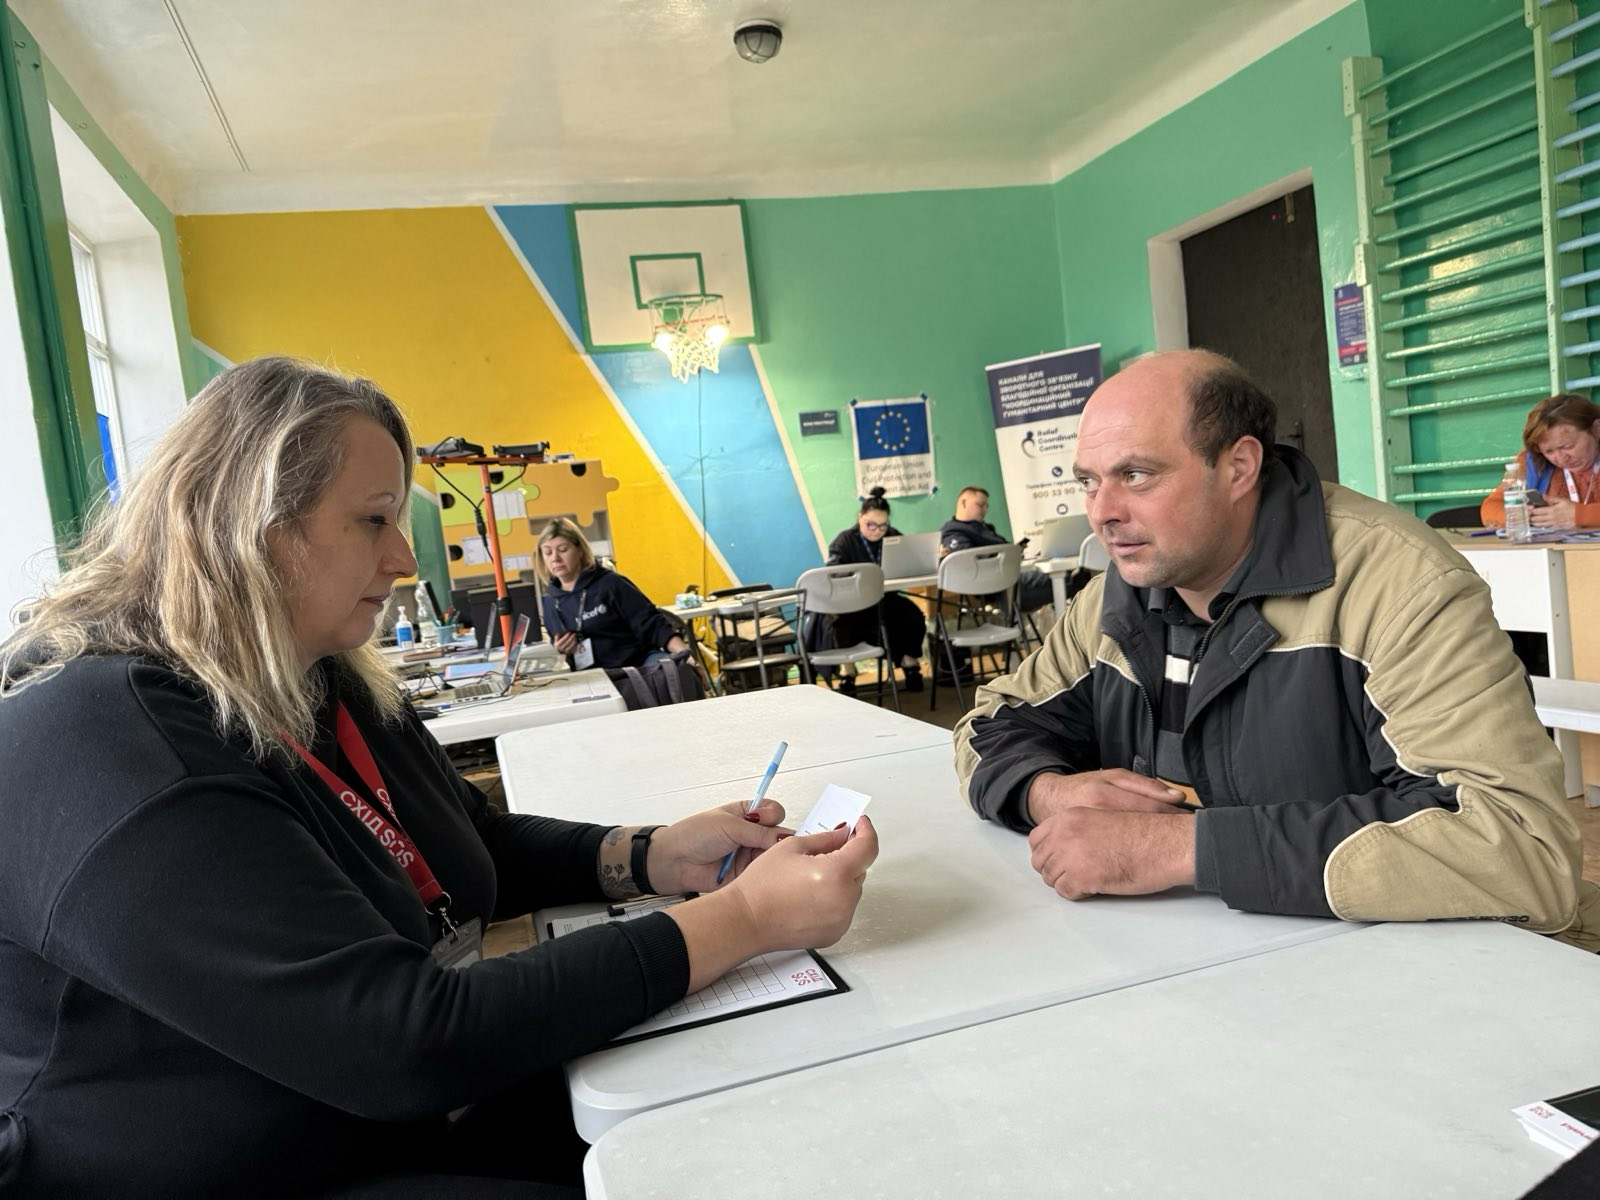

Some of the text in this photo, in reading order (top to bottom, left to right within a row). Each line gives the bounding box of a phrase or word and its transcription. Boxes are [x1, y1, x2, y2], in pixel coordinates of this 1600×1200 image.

[998, 370, 1044, 386] КАНАЛИ ДЛЯ
[1000, 379, 1046, 394] ЗВОРОТНОГО
[1001, 377, 1094, 402] БЛАГОДІЙНОЇ ОРГАНІЗАЦІЇ
[1003, 402, 1056, 418] ГУМАНІТАРНИЙ
[1037, 427, 1058, 437] Relief
[1038, 432, 1078, 444] Coordinati
[340, 790, 384, 836] СХІД
